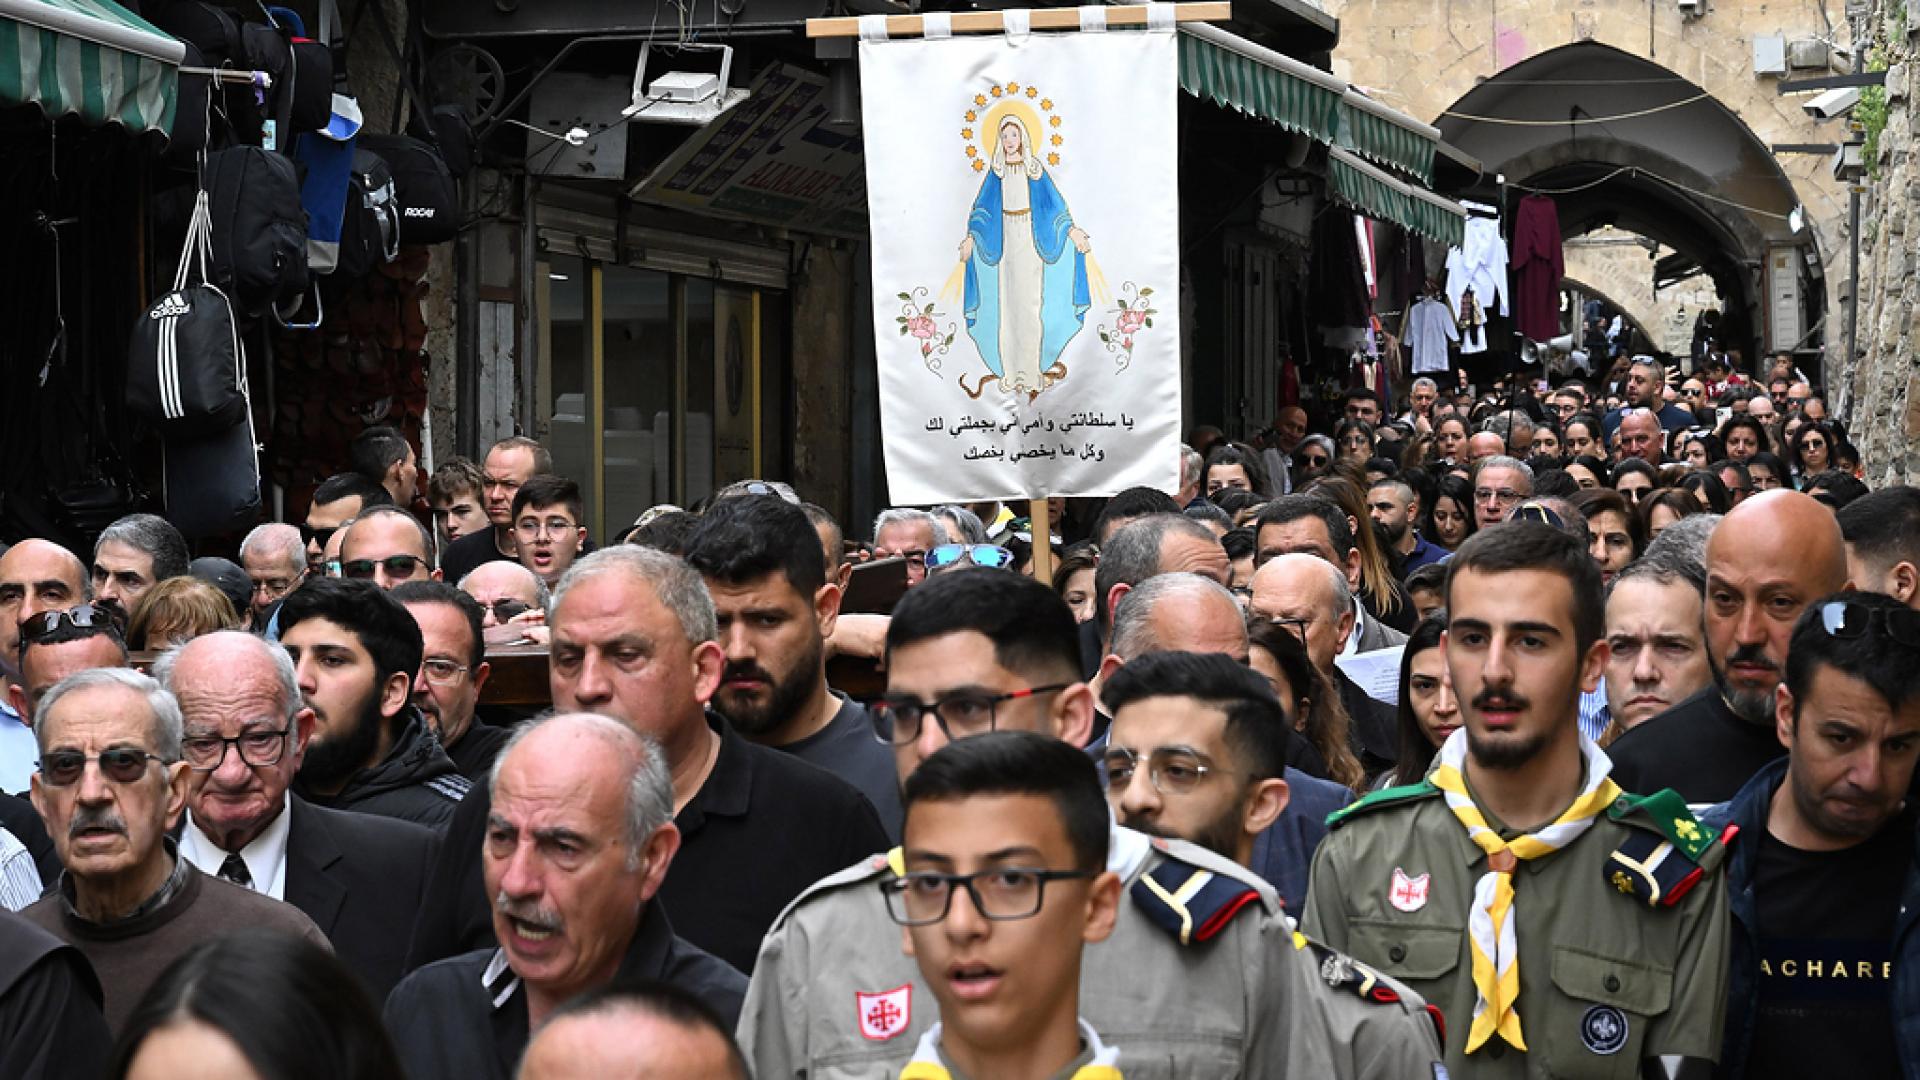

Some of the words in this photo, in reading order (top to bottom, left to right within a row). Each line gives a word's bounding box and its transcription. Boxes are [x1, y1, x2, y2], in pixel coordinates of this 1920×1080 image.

[150, 303, 190, 320] adidas
[926, 416, 943, 431] لك
[1060, 412, 1116, 434] سلطانتي
[1121, 413, 1134, 431] يا
[963, 445, 1004, 462] يخصك
[1060, 443, 1075, 456] ما
[1079, 443, 1104, 462] وكل
